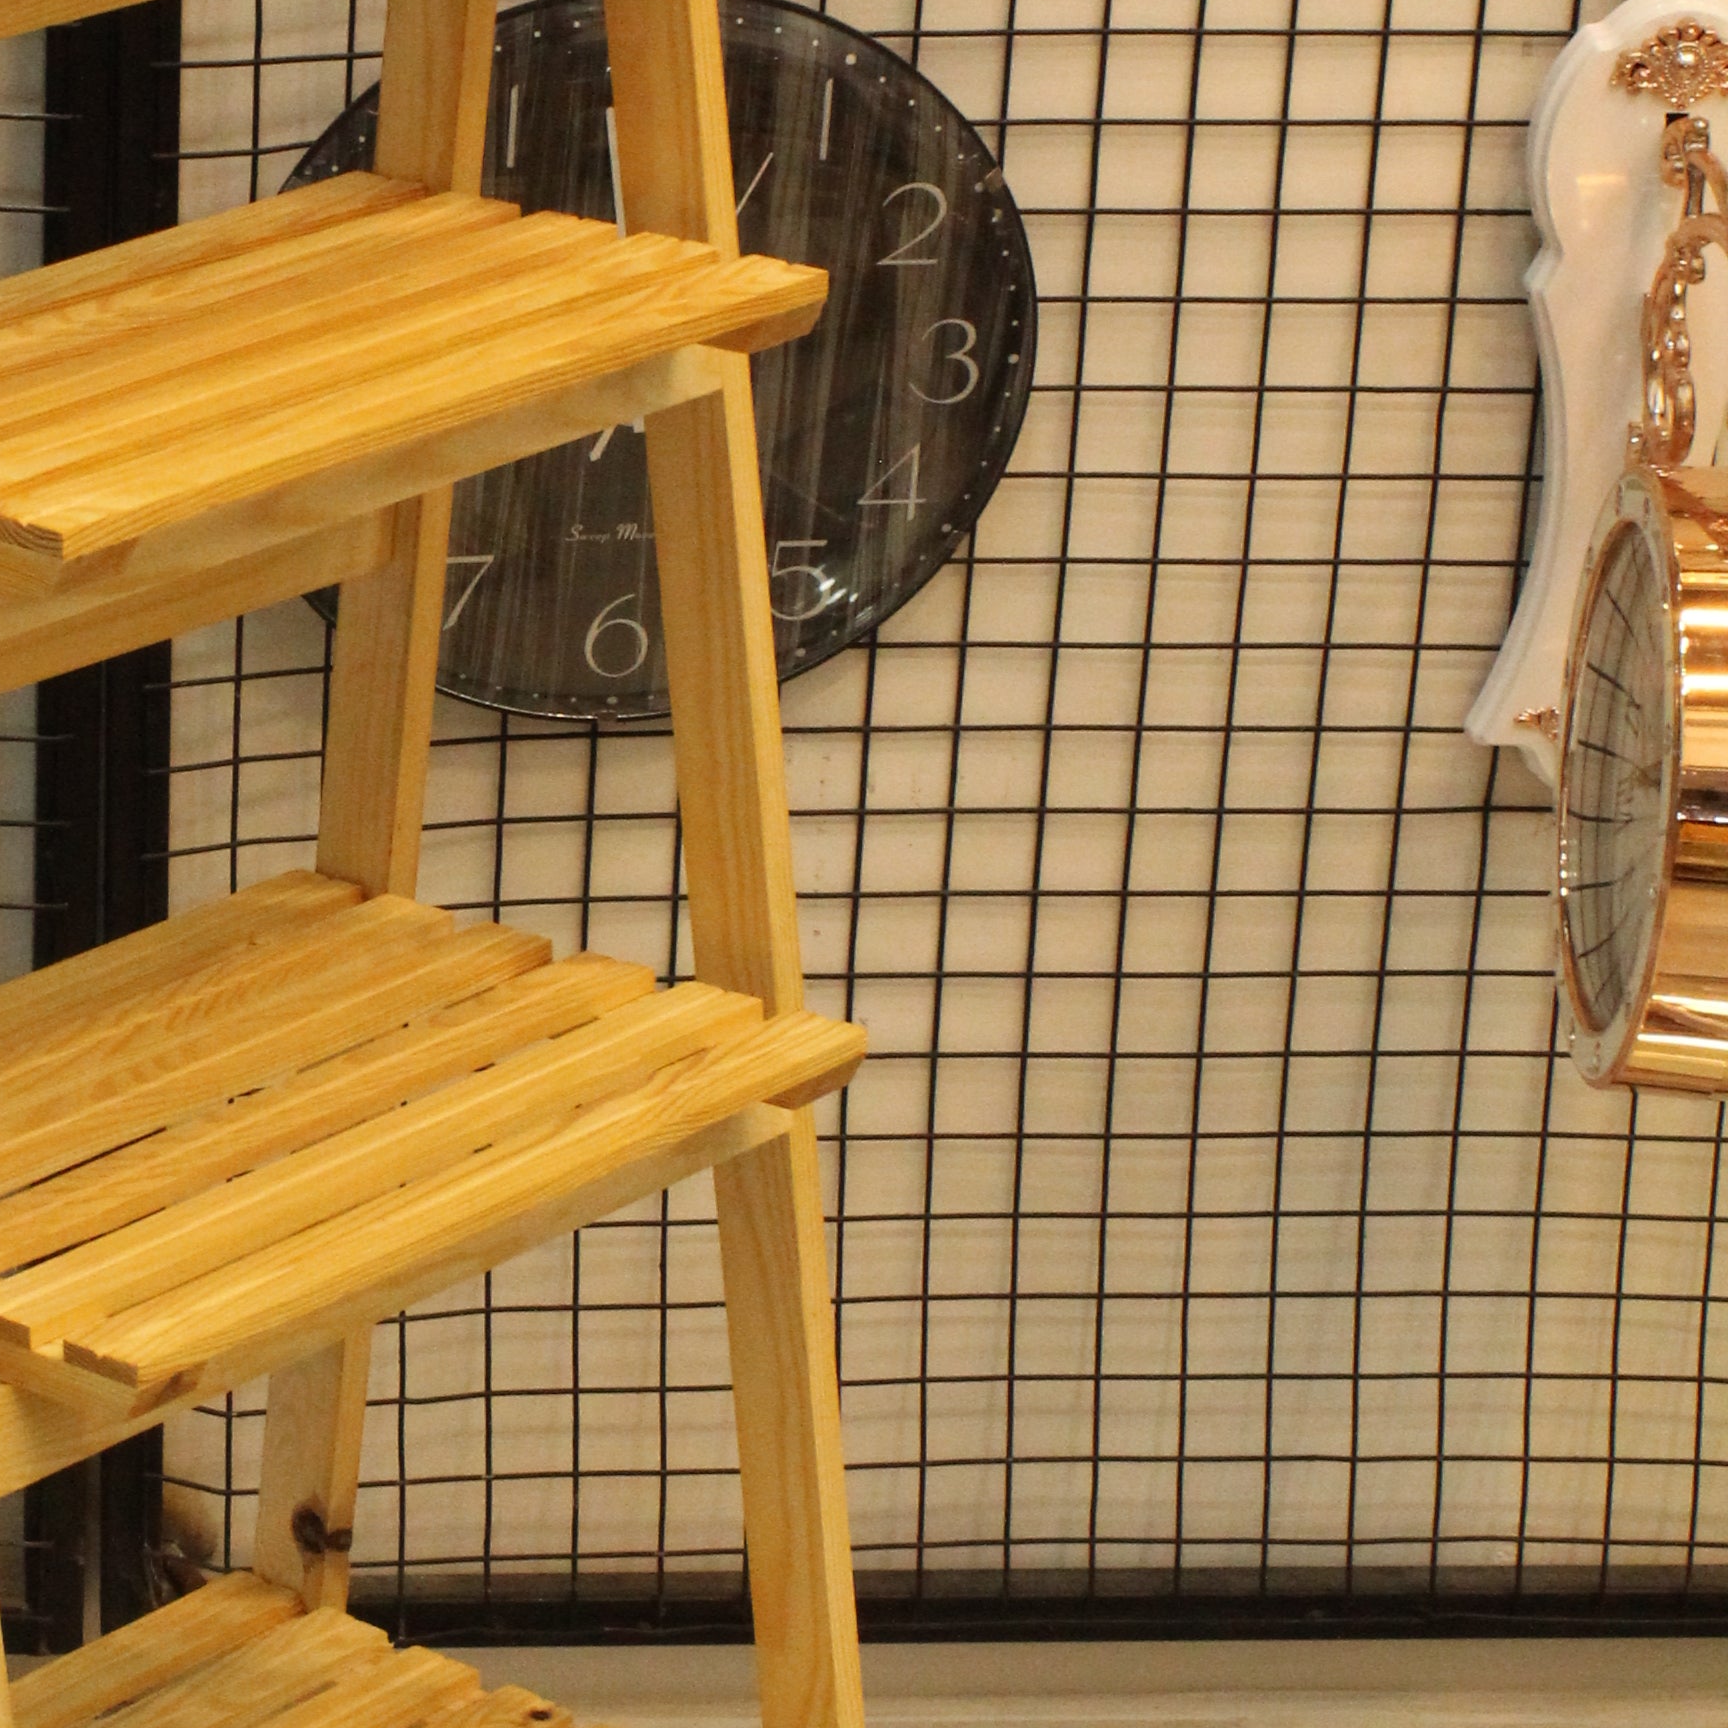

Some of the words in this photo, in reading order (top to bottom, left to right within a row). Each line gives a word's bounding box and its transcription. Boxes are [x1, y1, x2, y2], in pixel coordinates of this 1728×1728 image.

[819, 78, 834, 161] 1
[876, 181, 948, 267] 2
[908, 318, 979, 405] 3
[856, 442, 926, 522] 4
[442, 554, 495, 631] 7
[769, 539, 830, 620] 5
[584, 593, 648, 678] 6
